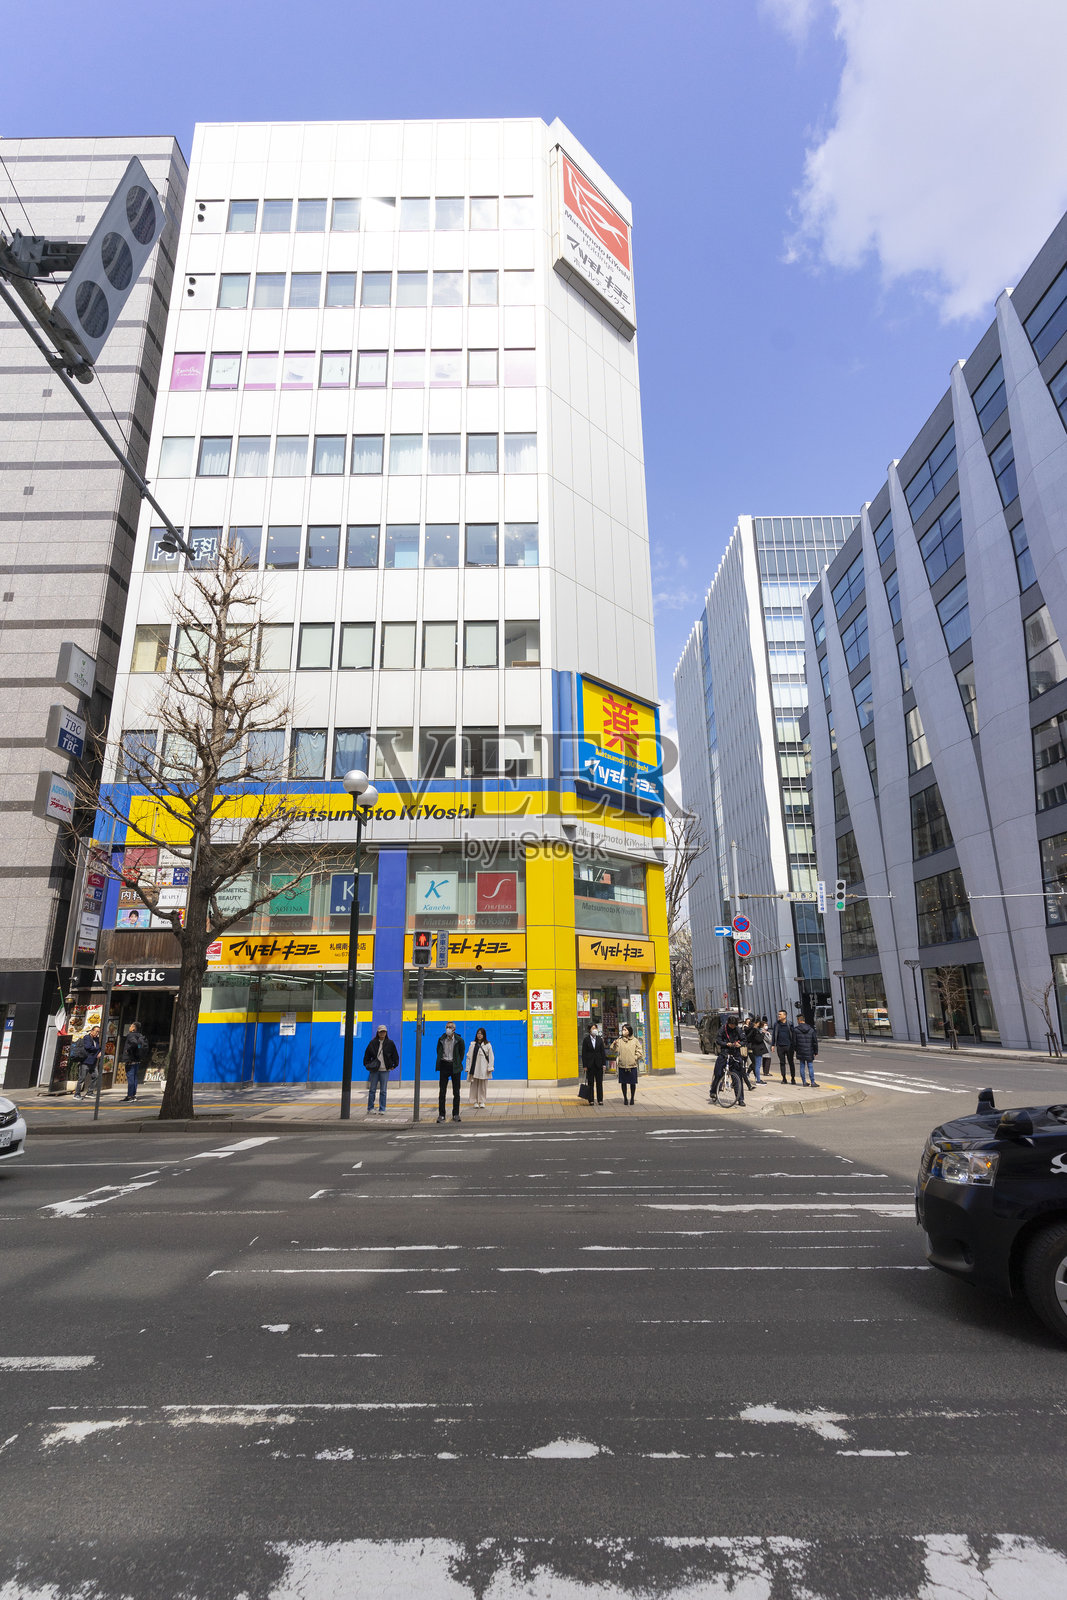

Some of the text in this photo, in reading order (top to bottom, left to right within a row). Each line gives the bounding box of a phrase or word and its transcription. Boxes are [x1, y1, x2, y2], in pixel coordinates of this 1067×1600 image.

[564, 210, 605, 258] Matsumoto
[65, 717, 82, 735] TBC
[602, 694, 639, 758] 薬
[62, 737, 80, 754] TBC
[278, 804, 477, 822] Matsumoto KiYoshi
[229, 940, 320, 960] マツモトキヨシ
[590, 941, 645, 961] マツモトキヨシ
